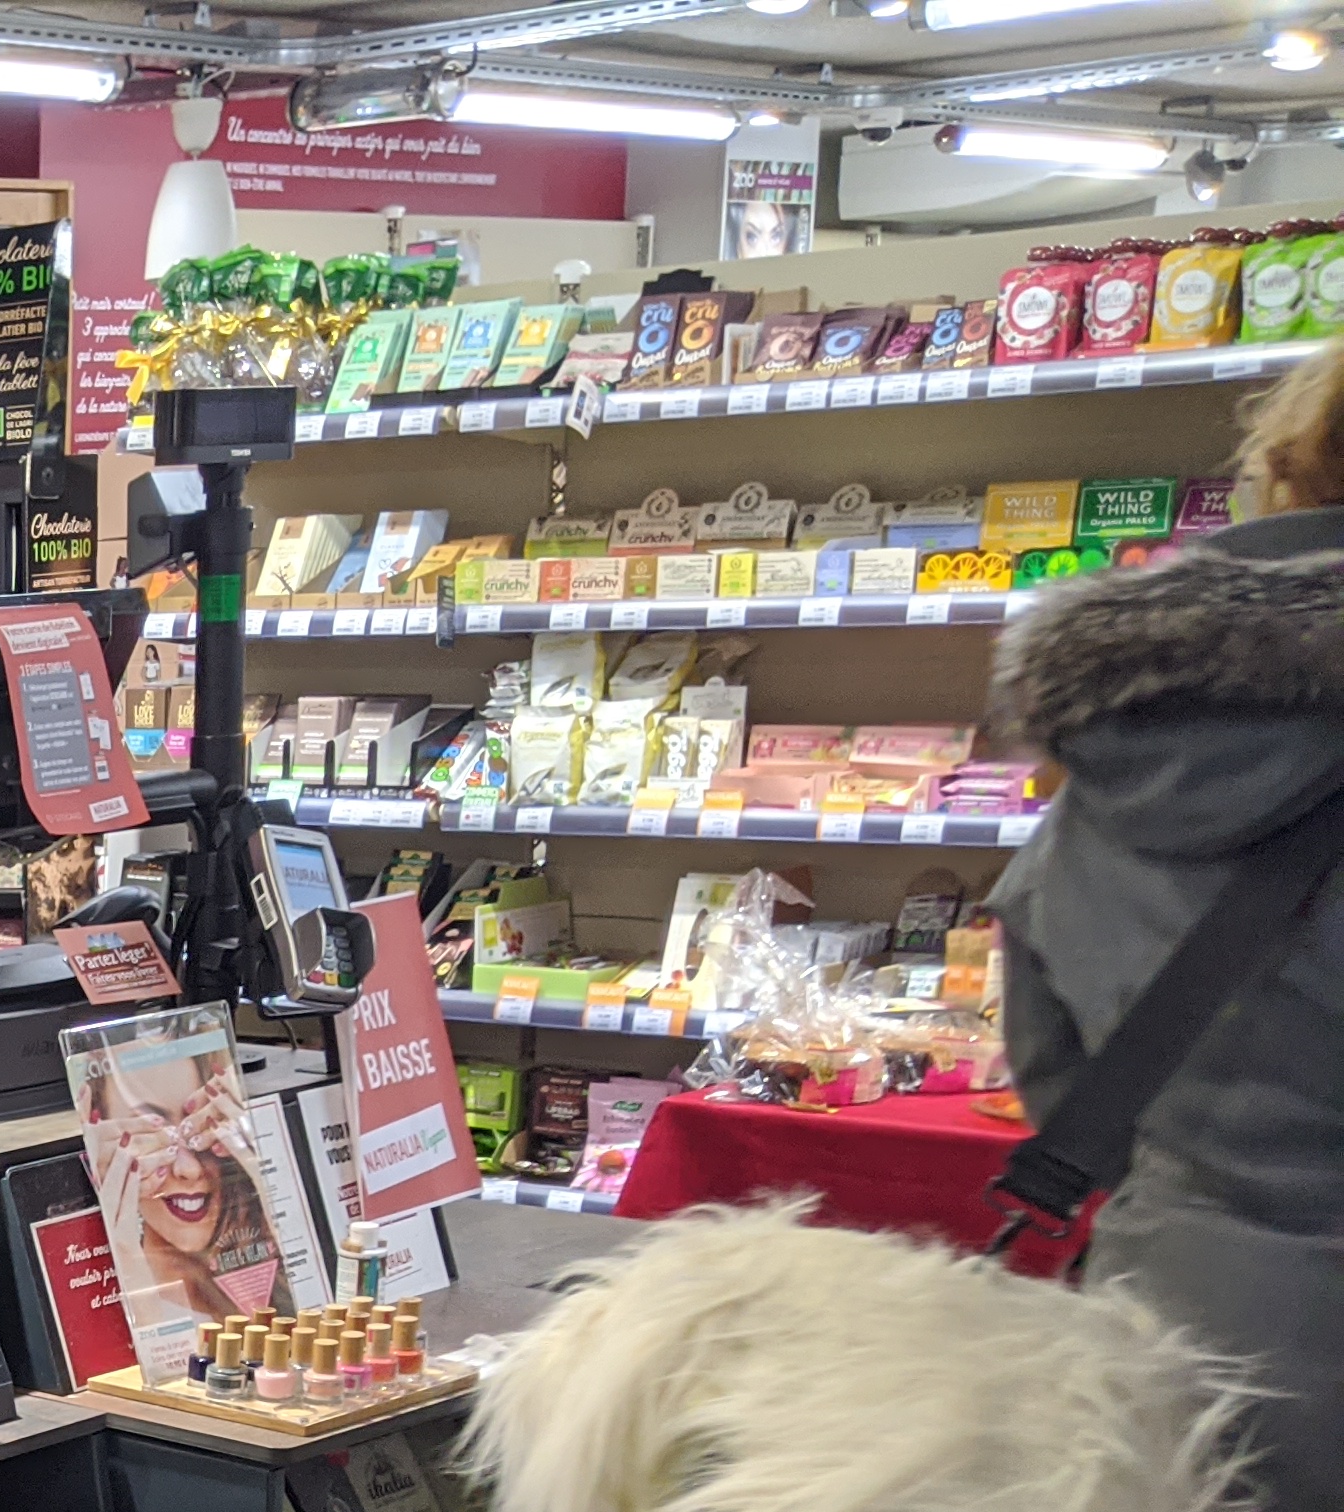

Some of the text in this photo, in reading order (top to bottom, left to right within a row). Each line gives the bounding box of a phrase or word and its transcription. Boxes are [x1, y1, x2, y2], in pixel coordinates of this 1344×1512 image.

[28, 323, 44, 335] BIO
[13, 351, 40, 374] fève
[0, 374, 39, 392] tablett
[1096, 489, 1155, 504] WILD
[1096, 502, 1154, 516] THING
[31, 512, 92, 539] Chocolaterie
[1124, 515, 1157, 526] PALEO
[32, 538, 92, 563] 100% BIO
[484, 574, 530, 593] crunchy
[571, 574, 619, 593] crunchy
[74, 951, 118, 973] Partez
[362, 1037, 438, 1091] BAISSE
[363, 1133, 422, 1175] NATURALIA
